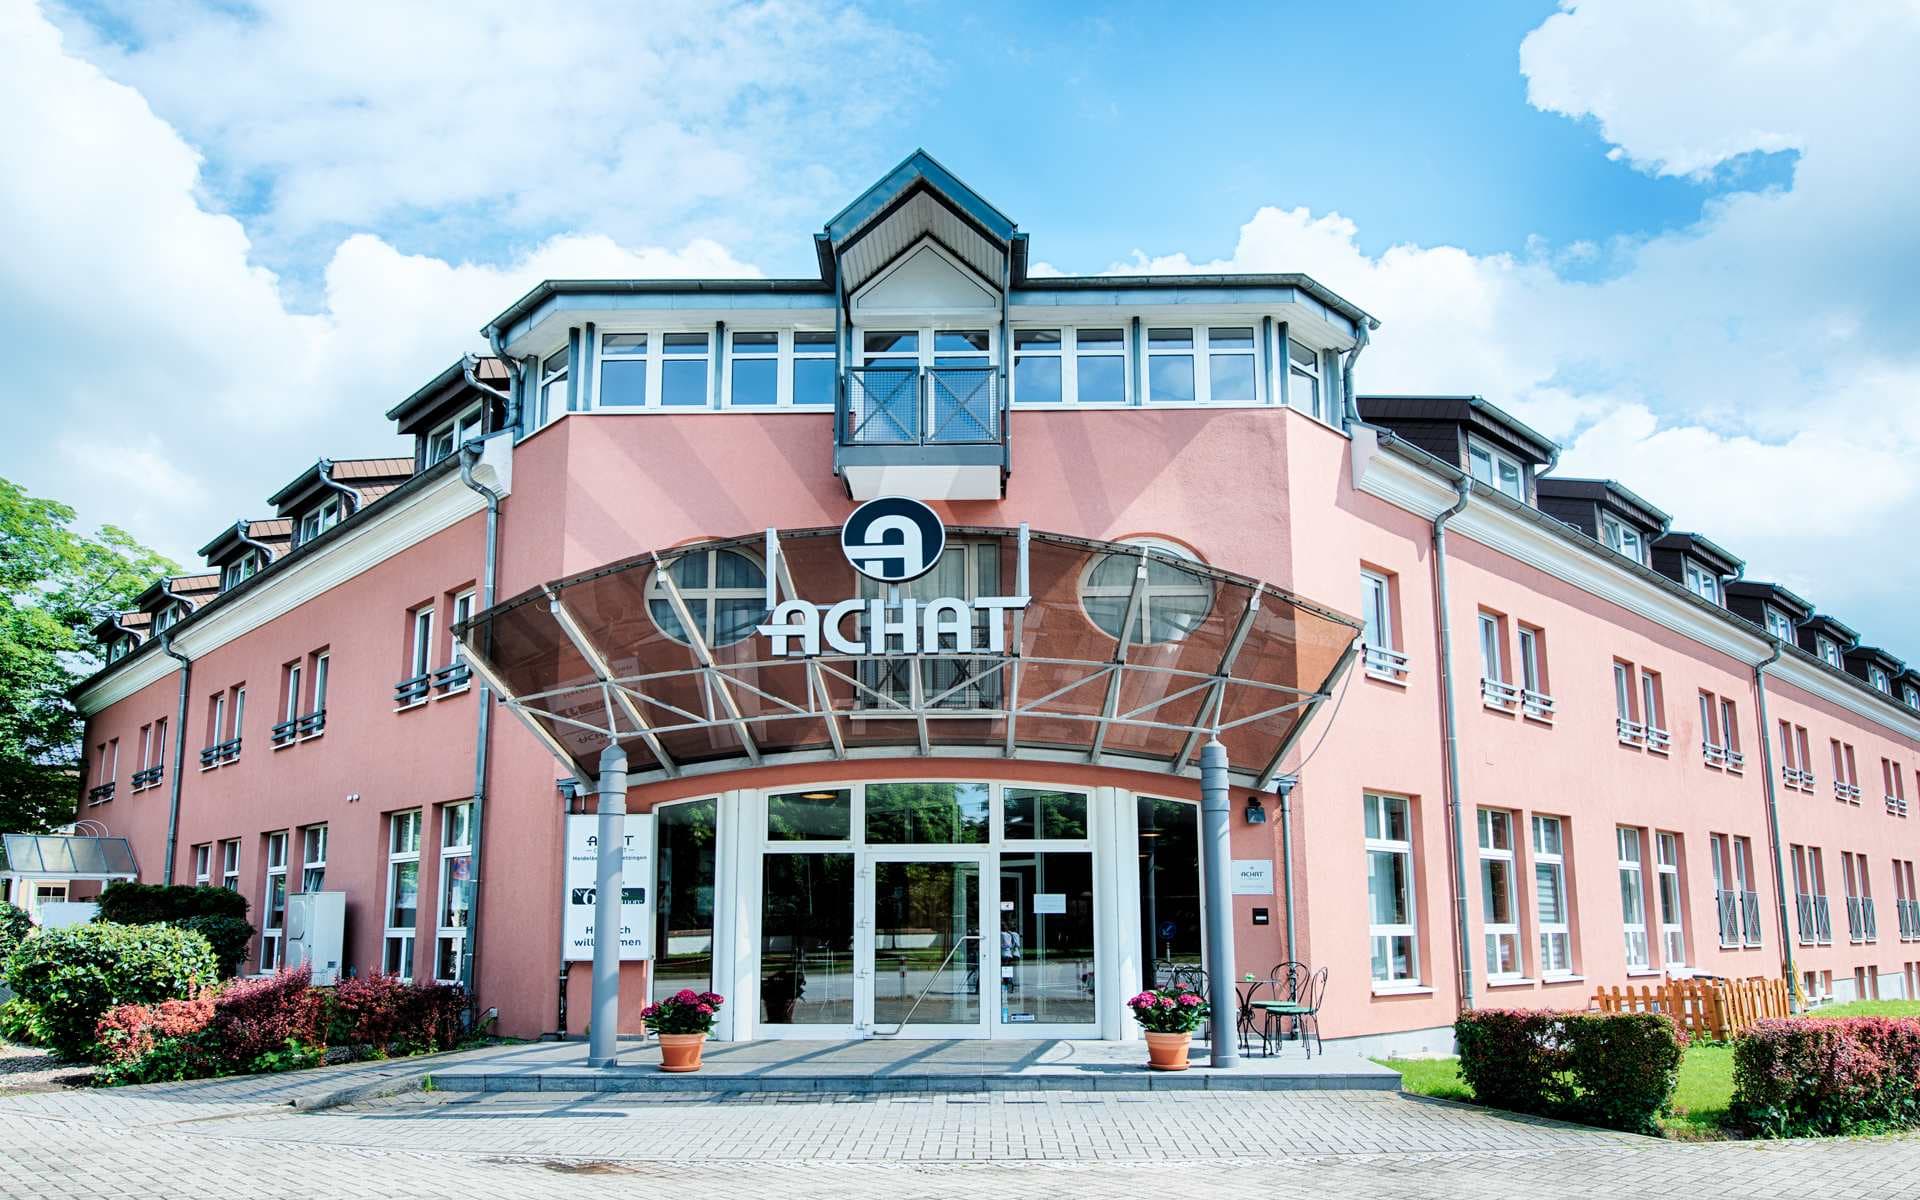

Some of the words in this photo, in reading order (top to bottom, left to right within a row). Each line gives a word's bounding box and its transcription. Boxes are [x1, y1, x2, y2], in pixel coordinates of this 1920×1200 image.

[844, 514, 923, 578] A
[756, 597, 1032, 656] ACHAT
[574, 938, 641, 947] willmen
